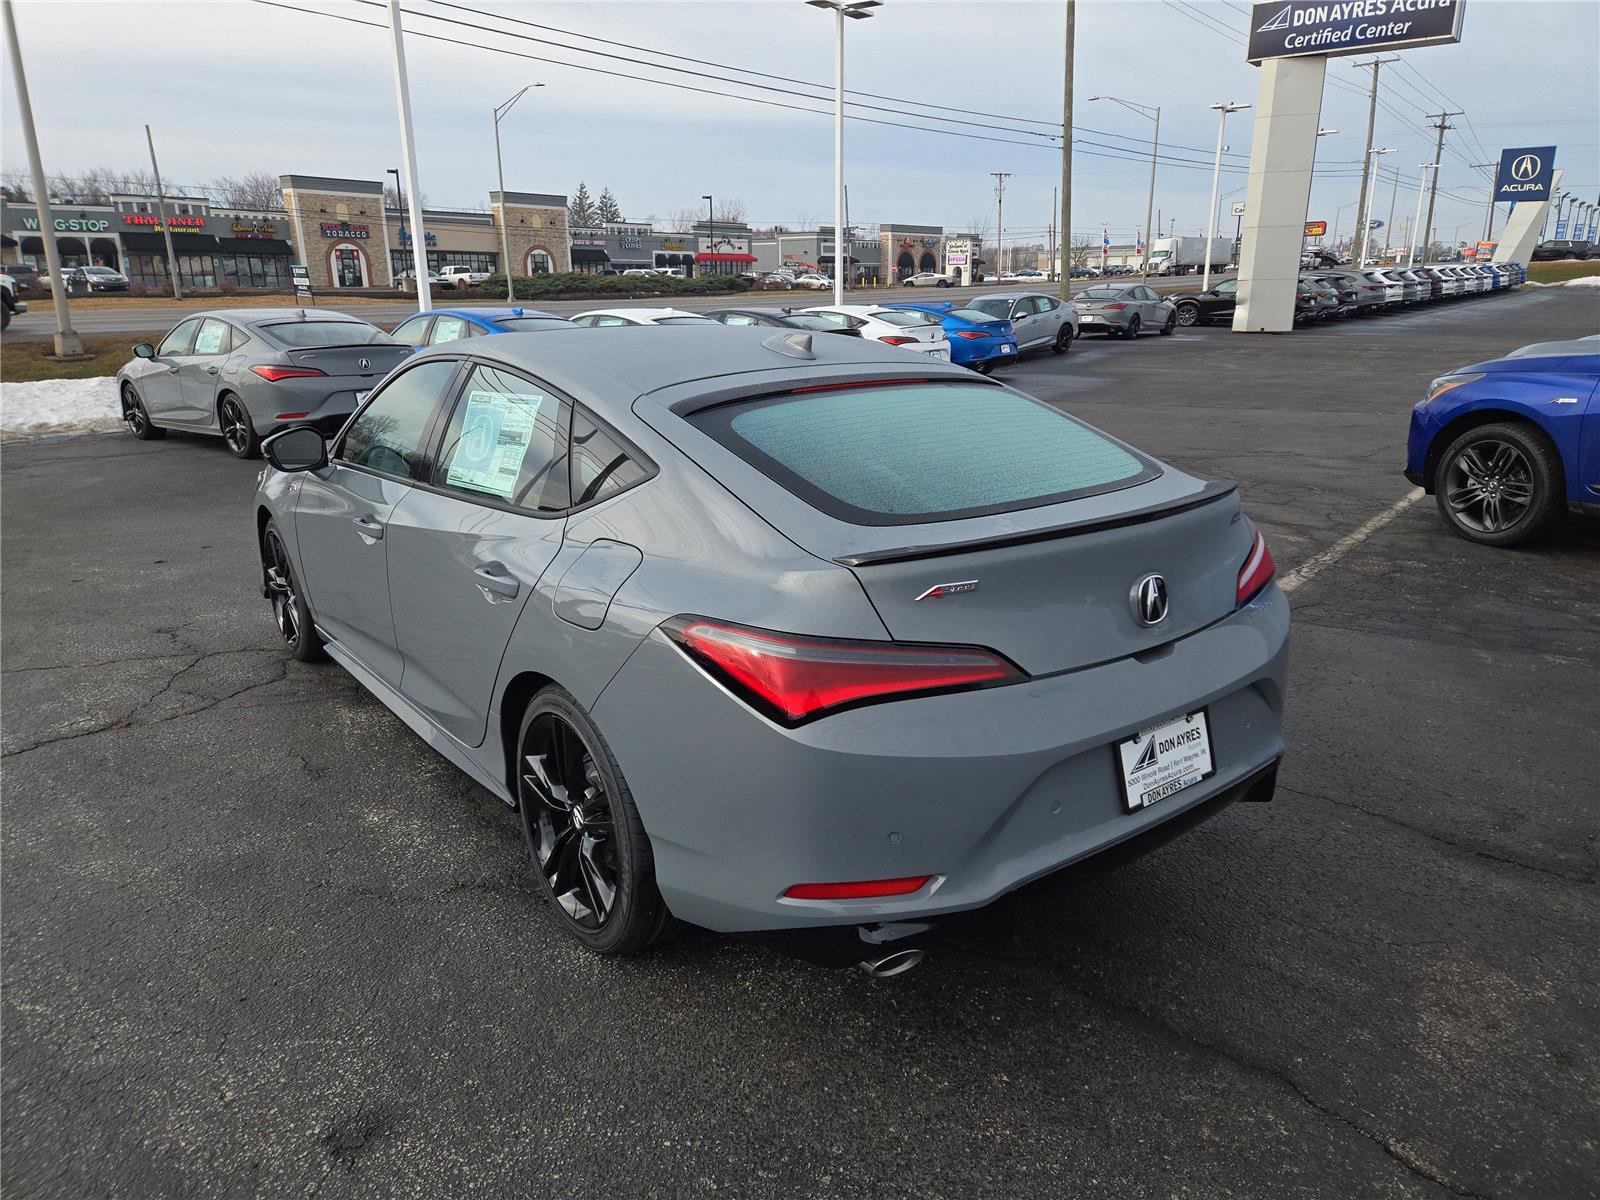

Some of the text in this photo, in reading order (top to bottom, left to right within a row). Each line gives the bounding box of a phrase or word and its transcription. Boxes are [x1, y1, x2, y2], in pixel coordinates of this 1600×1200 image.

[1293, 7, 1328, 27] DON
[1329, 0, 1387, 22] AYRES
[1285, 20, 1412, 49] Certified Center
[1500, 183, 1544, 192] ACURA
[123, 215, 160, 225] THAI
[154, 225, 200, 233] Retaurant
[326, 230, 367, 238] TOBACCO
[1159, 727, 1201, 754] DON AYRES
[1147, 789, 1162, 803] DON
[1162, 779, 1182, 797] AYRES
